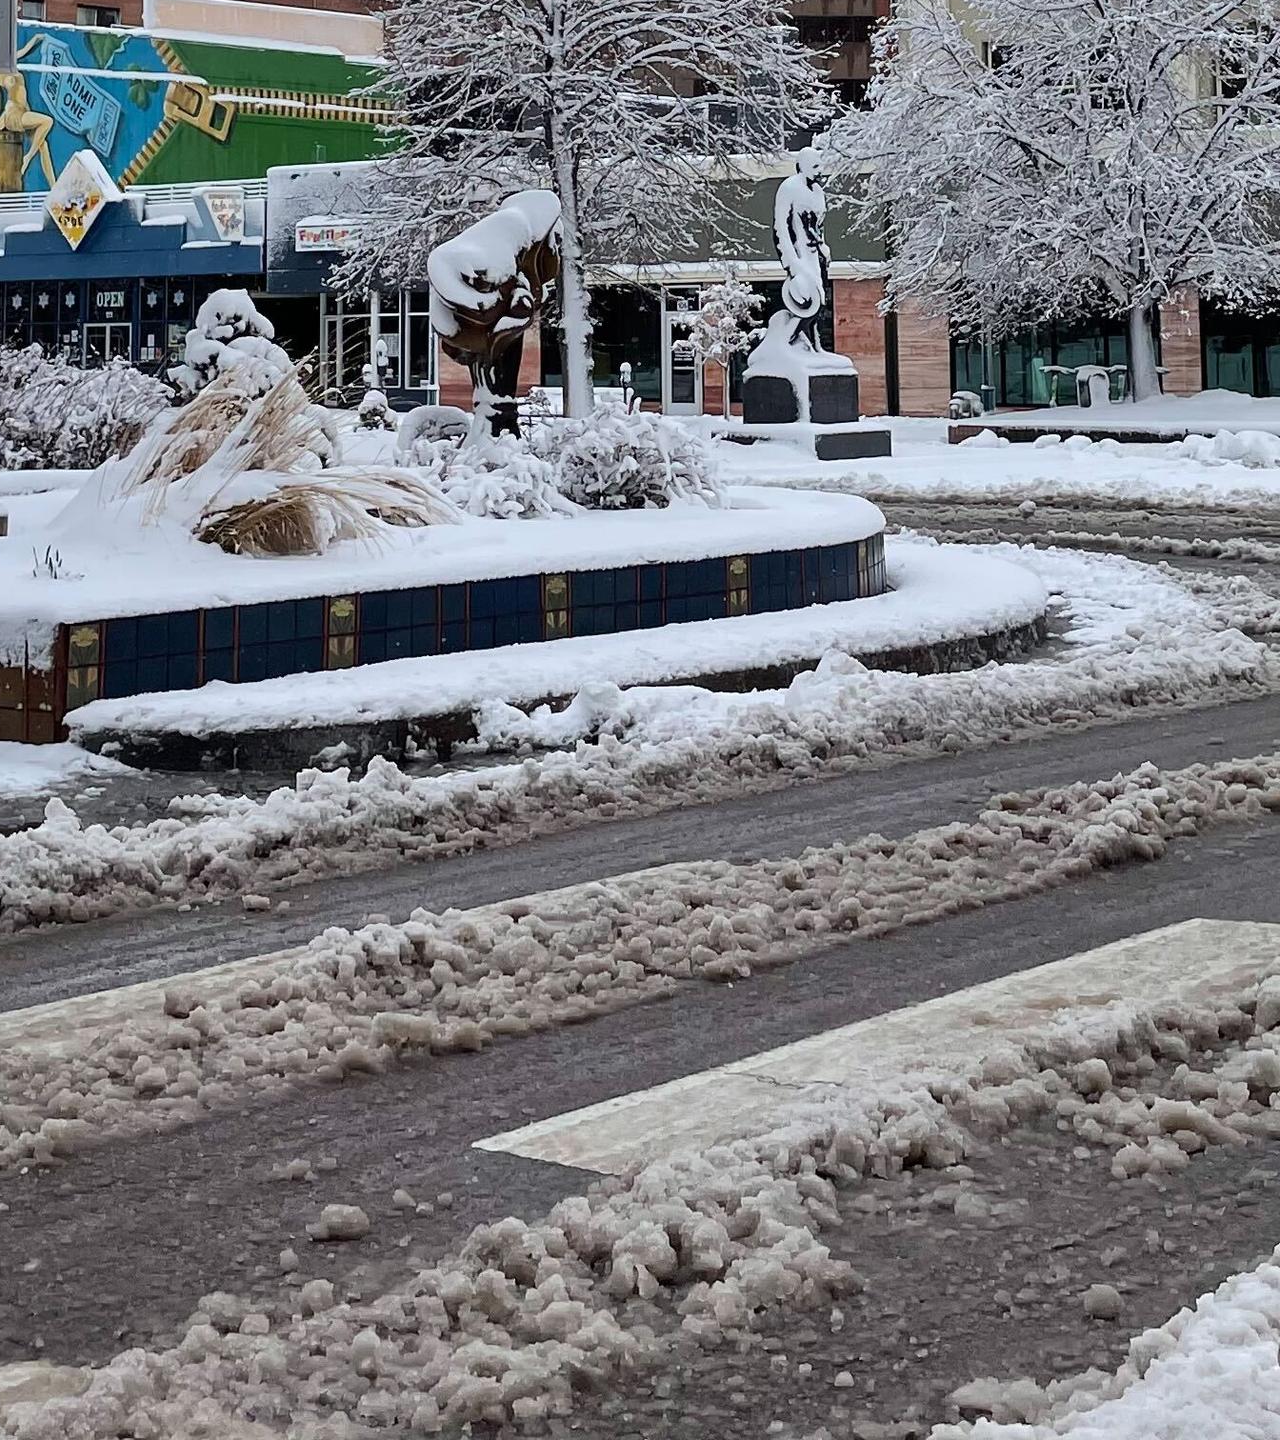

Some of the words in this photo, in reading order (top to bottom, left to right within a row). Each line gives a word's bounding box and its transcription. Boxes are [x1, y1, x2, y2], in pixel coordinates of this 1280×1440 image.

[66, 73, 98, 110] ADMIT
[63, 92, 87, 122] ONE
[97, 291, 124, 308] OPEN
